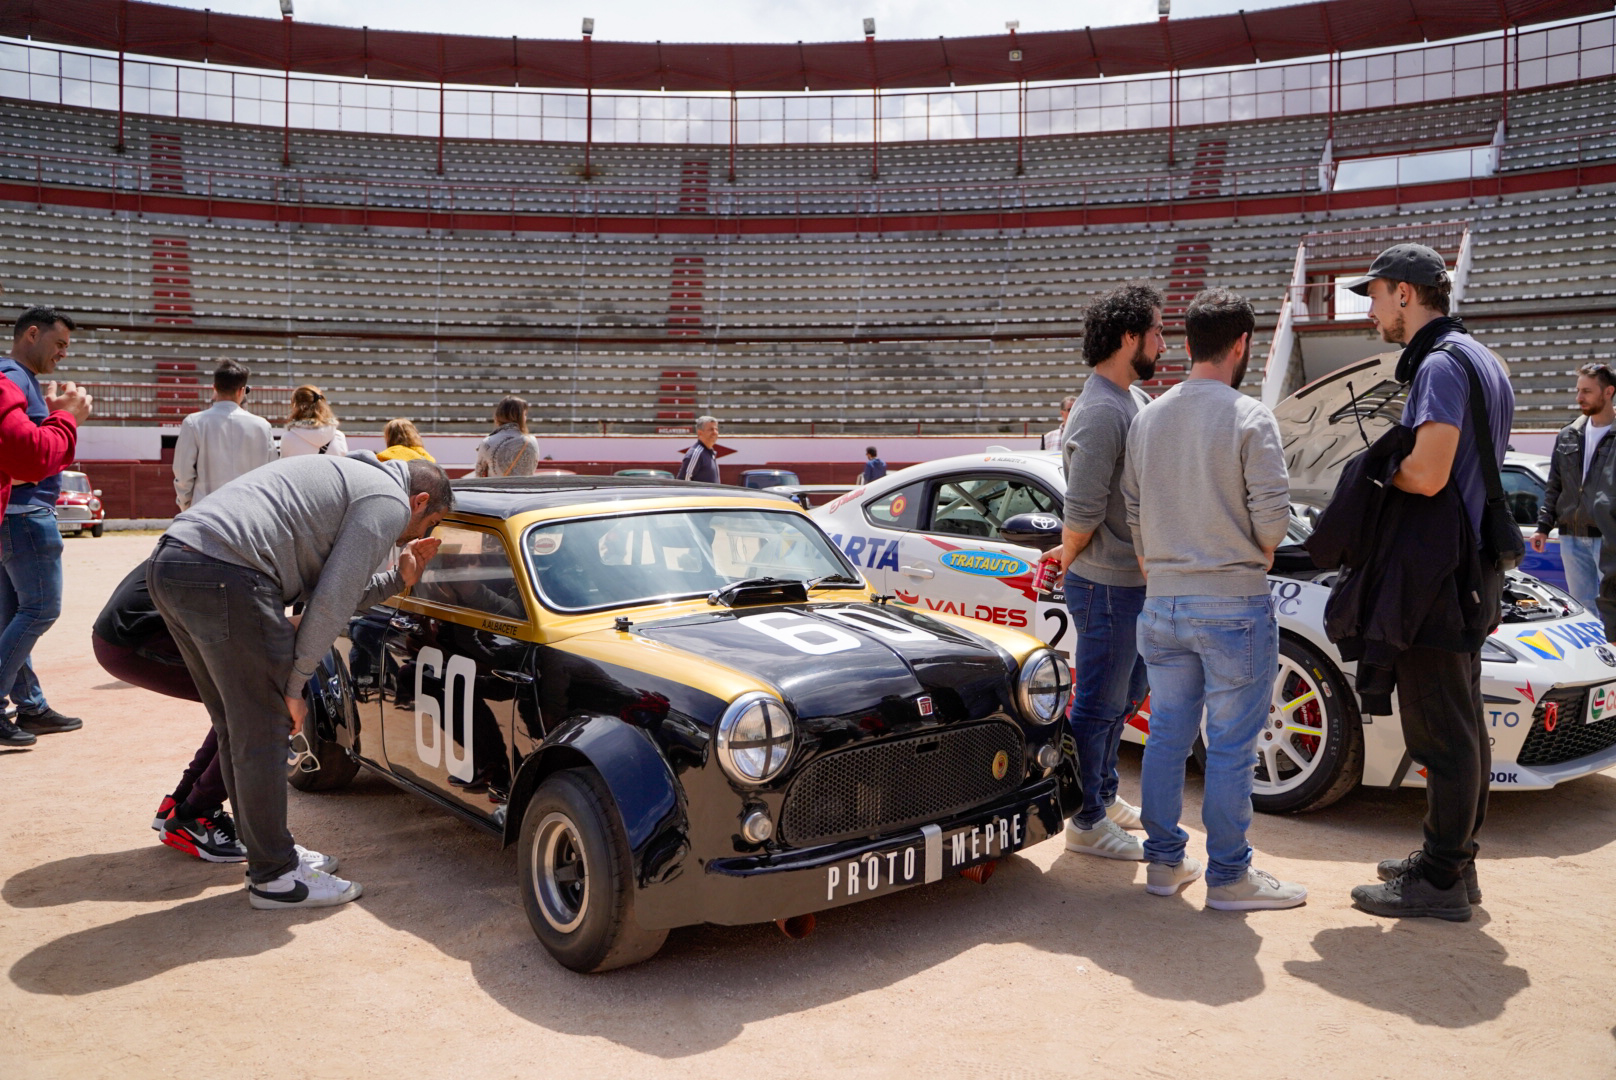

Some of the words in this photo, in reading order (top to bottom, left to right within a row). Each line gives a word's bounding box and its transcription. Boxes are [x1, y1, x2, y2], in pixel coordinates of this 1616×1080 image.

[827, 533, 899, 572] ARTA
[950, 553, 1018, 573] TRATAUTO
[738, 608, 938, 655] 60
[925, 597, 1028, 627] VALDES
[415, 646, 476, 783] 60
[827, 847, 915, 900] PROTO
[952, 814, 1021, 866] MEPRE
